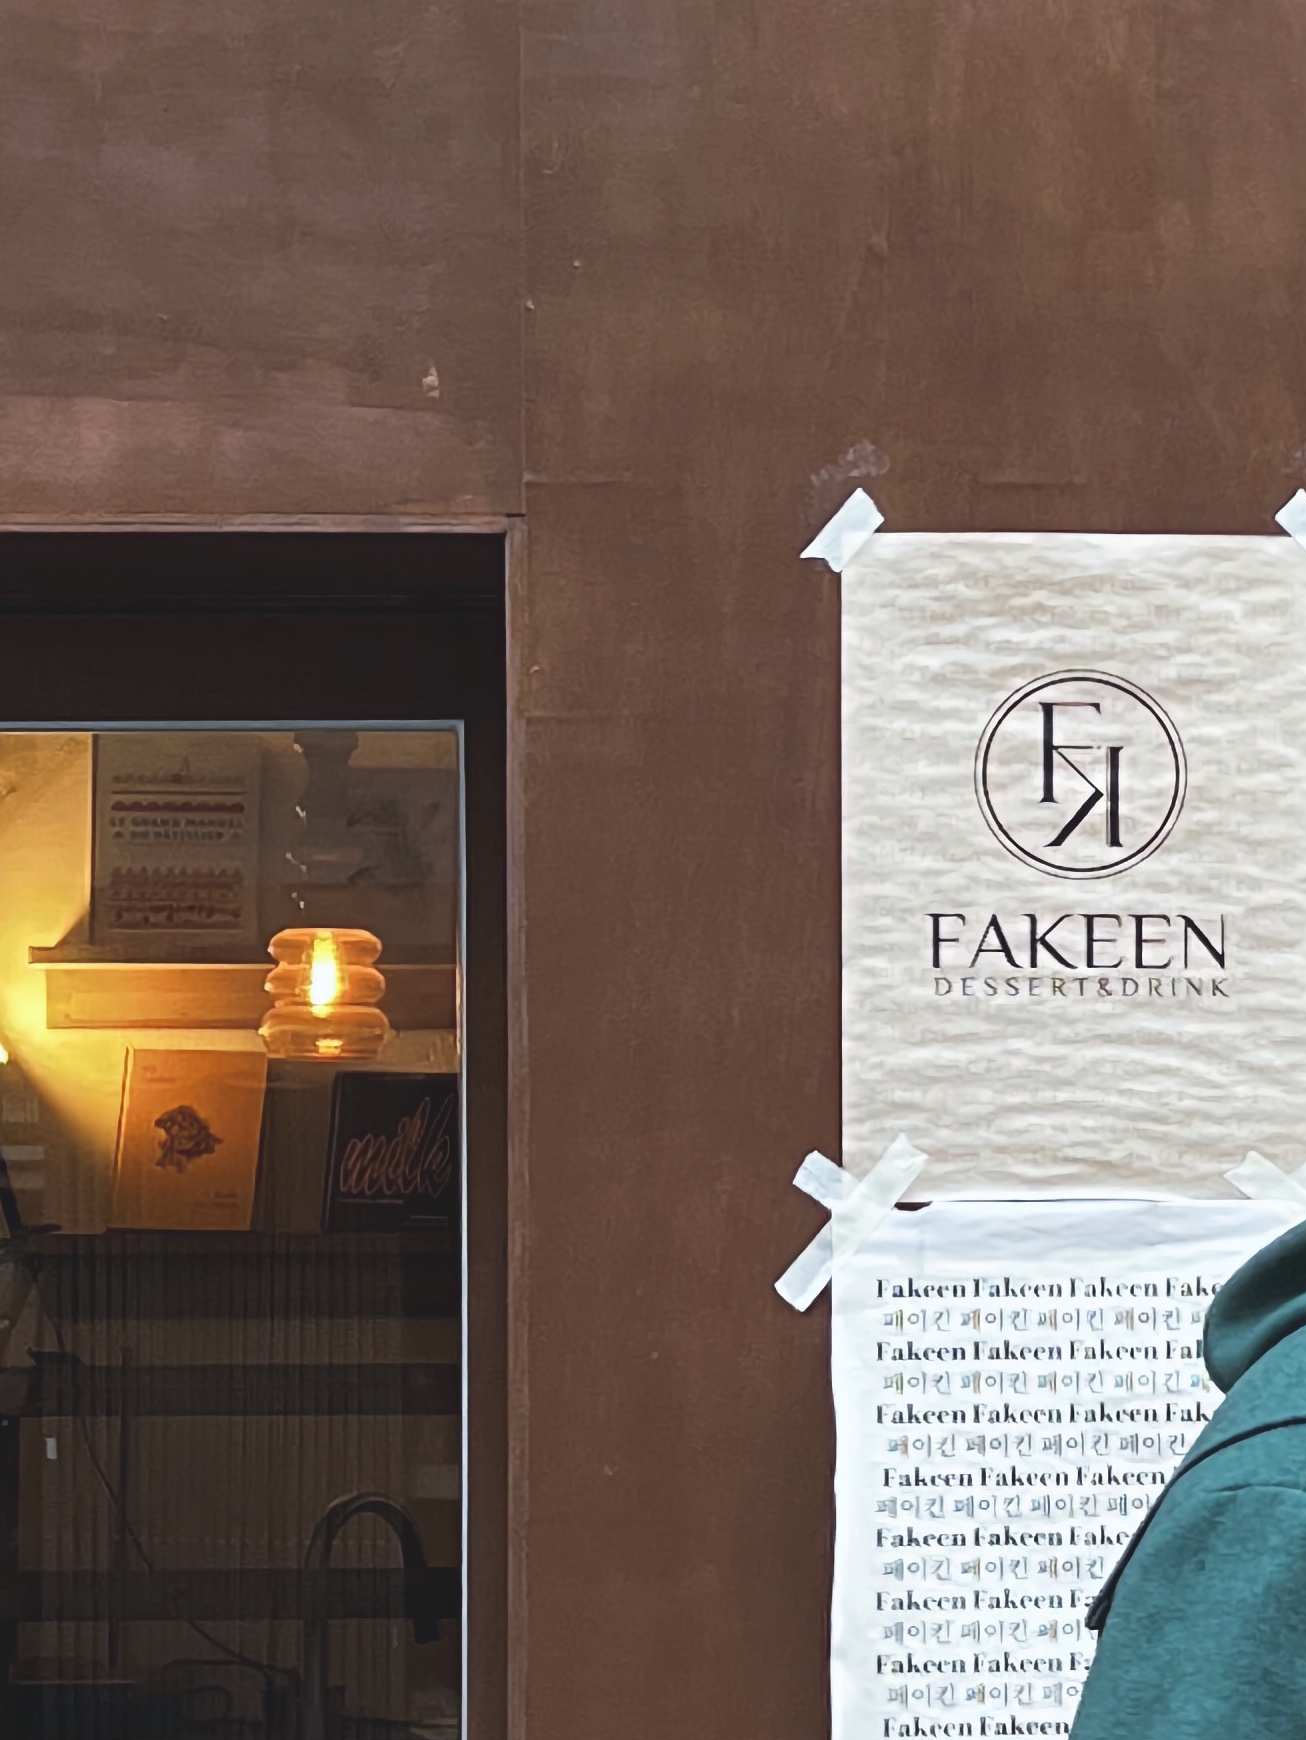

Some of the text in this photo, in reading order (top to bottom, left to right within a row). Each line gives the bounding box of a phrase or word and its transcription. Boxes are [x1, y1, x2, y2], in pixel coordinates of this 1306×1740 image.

[926, 911, 1228, 971] FAKEEN
[933, 975, 1231, 1000] DESSERT&DRINK
[876, 1276, 966, 1299] Fakeen
[973, 1276, 1062, 1299] Fakeen
[1070, 1276, 1158, 1299] Fakeen
[876, 1339, 966, 1362] Fakeen
[973, 1339, 1062, 1362] Fakeen
[1070, 1339, 1158, 1362] Fakeen
[876, 1402, 966, 1425] Fakeen
[973, 1402, 1062, 1425] Fakeen
[1070, 1402, 1158, 1425] Fakeen
[883, 1465, 1166, 1488] Fakeen Fakeen Fakeen
[876, 1525, 966, 1548] Fakeen
[973, 1525, 1063, 1548] Fakeen
[876, 1588, 966, 1611] Fakeen
[973, 1588, 1063, 1611] Fakeen
[876, 1652, 966, 1676] Fakeen
[973, 1652, 1063, 1676] Fakeen
[883, 1715, 1070, 1739] Fakeen Fakeen
